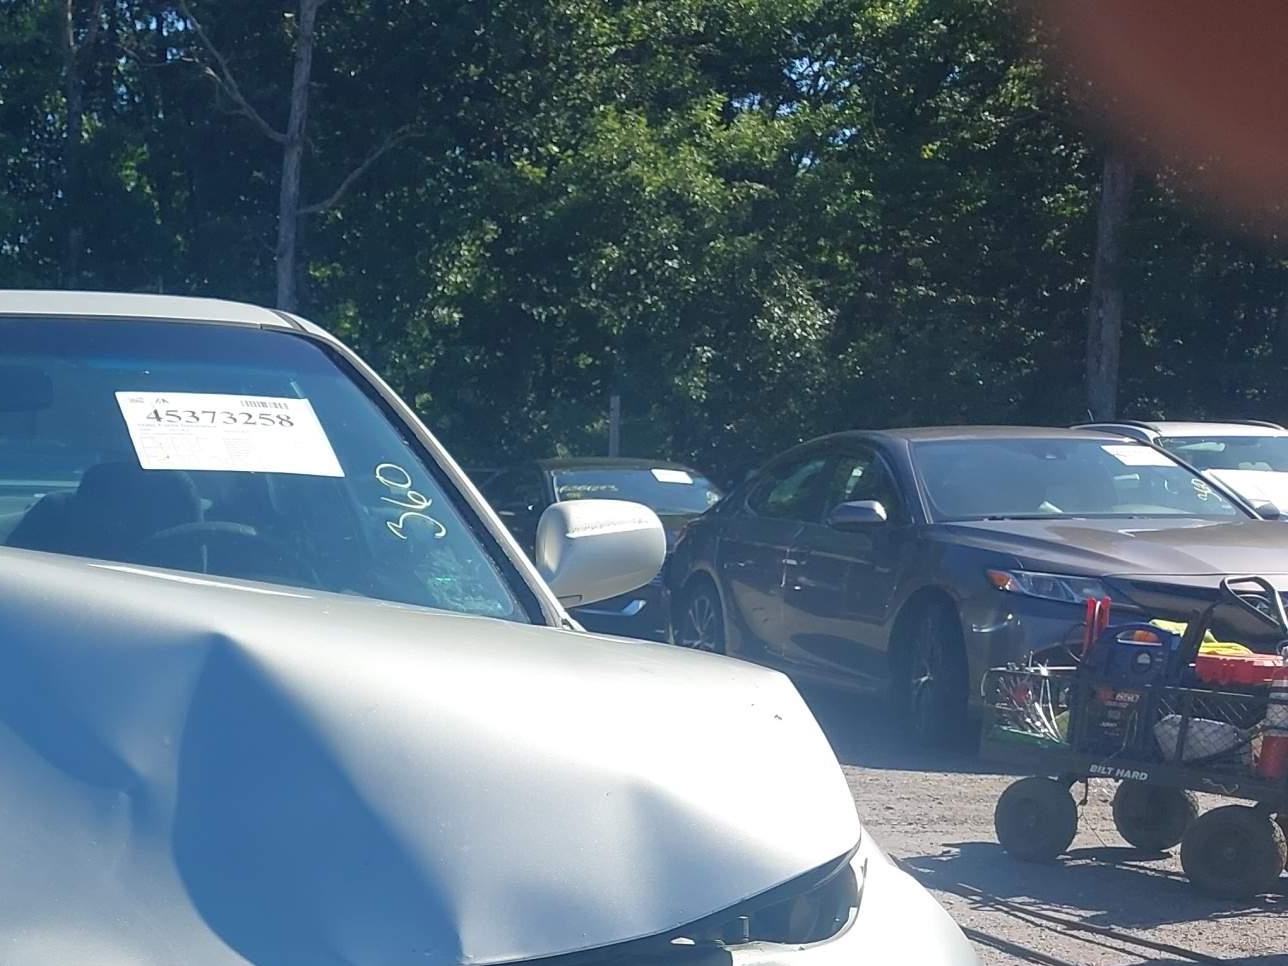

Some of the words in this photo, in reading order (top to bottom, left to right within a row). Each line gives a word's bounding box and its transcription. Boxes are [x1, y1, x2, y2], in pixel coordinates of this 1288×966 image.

[145, 408, 294, 428] 45373258
[375, 463, 447, 540] 360
[1089, 764, 1114, 776] BILT
[1115, 768, 1149, 781] HARD
